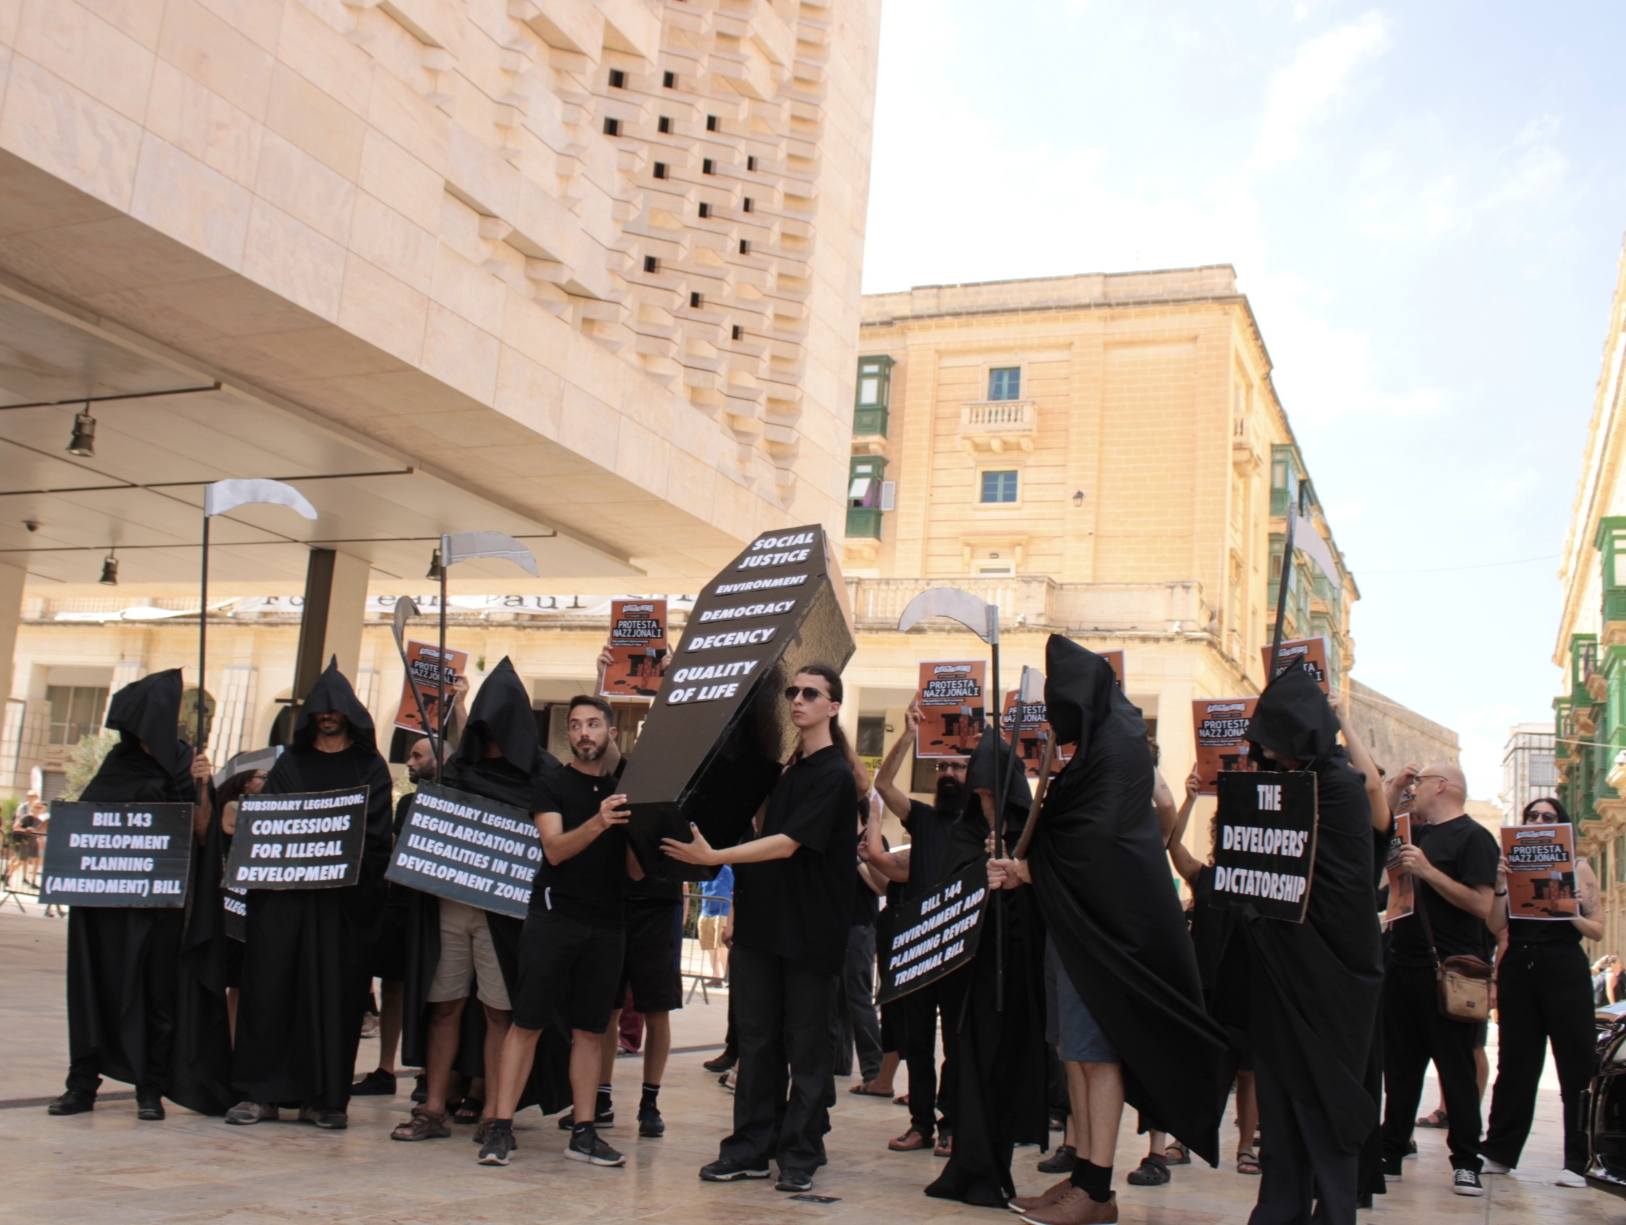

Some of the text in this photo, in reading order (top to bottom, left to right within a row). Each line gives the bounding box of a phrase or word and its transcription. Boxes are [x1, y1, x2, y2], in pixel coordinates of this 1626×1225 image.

[752, 532, 814, 551] SOCIAL
[737, 549, 811, 569] JUSTICE
[715, 574, 808, 594] ENVIRONMENT
[700, 600, 796, 622] DEMOCRACY
[618, 620, 657, 629] PROTESTA
[688, 627, 775, 651] DECENCY
[673, 660, 758, 683] QUALITY
[668, 682, 739, 703] OF LIFE
[923, 687, 979, 698] NAZZJONALI
[929, 680, 975, 690] PROTESTA
[1199, 728, 1247, 738] NAZZJONA
[1204, 719, 1250, 729] PROTESTA
[241, 793, 364, 812] SUBSIDIARY LEGISLATION:
[1257, 784, 1282, 811] THE
[92, 812, 152, 827] BILL 143
[251, 815, 351, 835] CONCESSIONS
[415, 793, 540, 839] SUBSIDIARY LEGISLATIO
[69, 833, 170, 850] DEVELOPMENT
[410, 812, 525, 857] REGULARISATION
[1222, 825, 1308, 858] DEVELOPERS'
[251, 840, 343, 859] FOR ILLEGAL
[407, 833, 536, 882] ILLEGALITIES IN THE
[1508, 852, 1568, 862] NAZZJONALI
[1513, 844, 1562, 855] PROTESTA
[80, 856, 154, 872] PLANNING
[236, 863, 348, 882] DEVELOPMENT
[45, 876, 181, 897] (AMENDMENT) BILL
[396, 852, 532, 904] DEVELOPMENT ZONE
[1214, 865, 1307, 903] DICTATORSHIP
[920, 880, 962, 915] BILL 144
[892, 887, 985, 951] ENVIRONMENT AND
[889, 909, 980, 970] PLANNING REVIEW
[894, 939, 965, 987] TRIBUNAL BILL
